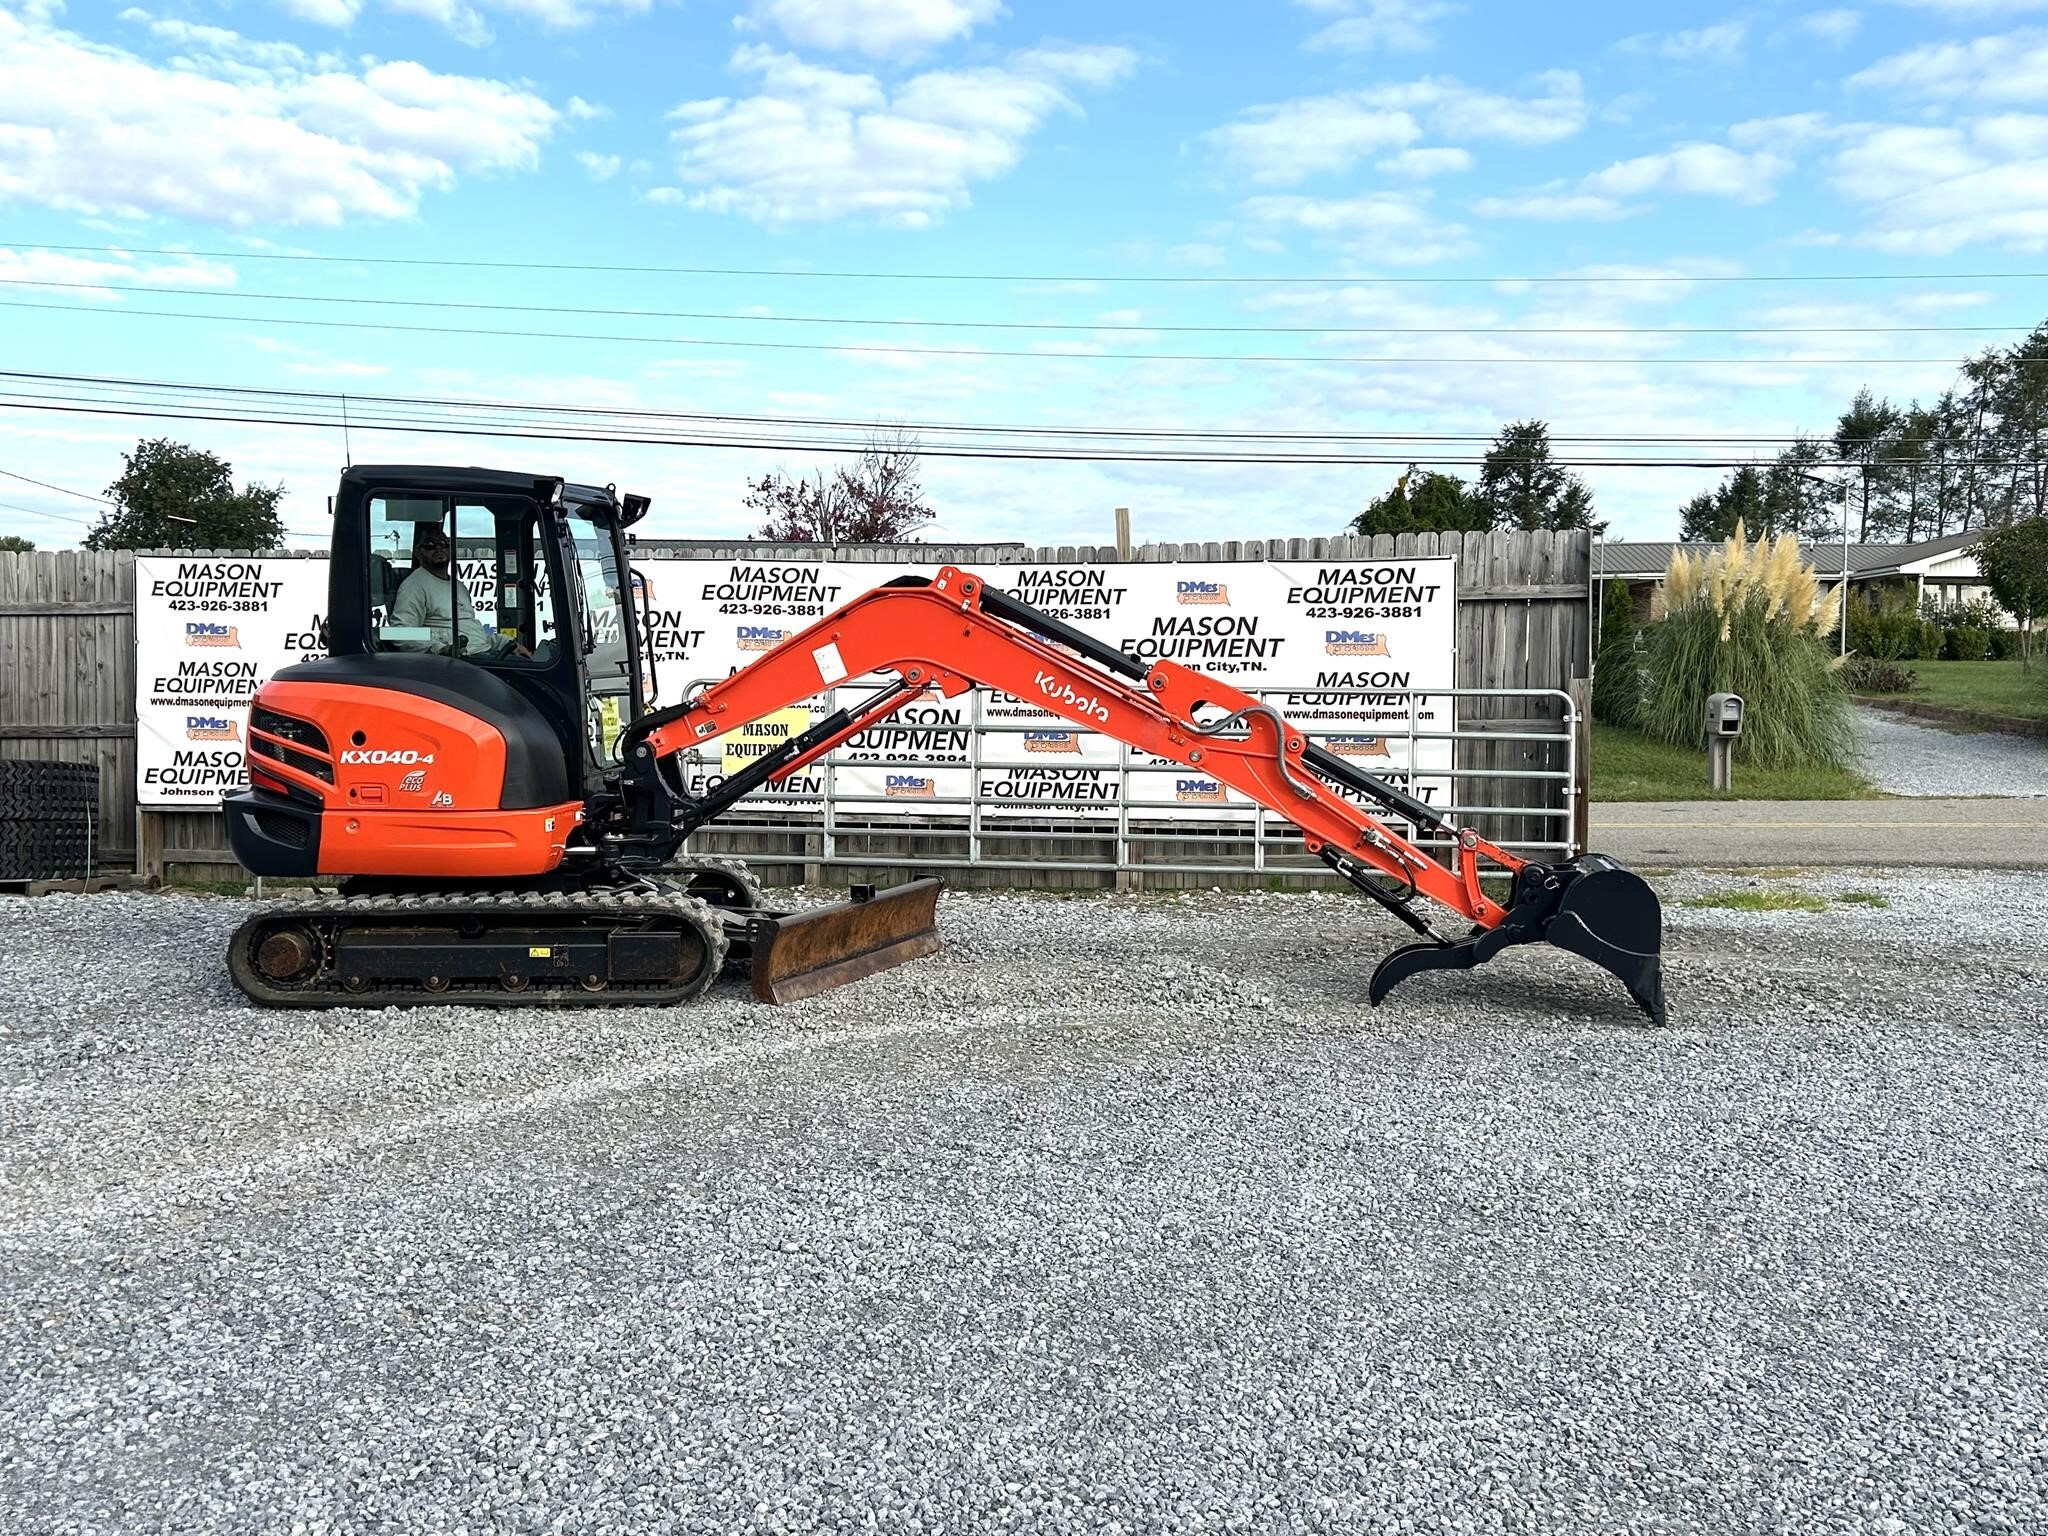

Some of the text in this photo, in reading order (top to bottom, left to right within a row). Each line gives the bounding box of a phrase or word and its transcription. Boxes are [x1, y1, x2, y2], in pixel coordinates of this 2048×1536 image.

[178, 564, 262, 580] MASON
[730, 566, 819, 584] MASON
[1017, 570, 1105, 587] MASON
[1317, 567, 1416, 586] MASON
[151, 581, 283, 598] EQUIPMENT
[702, 584, 841, 603] EQUIPMENT
[999, 588, 1127, 605] QUIPMENT
[1287, 586, 1440, 604] EQUIPMENT
[168, 600, 268, 612] 423-926-3881
[718, 603, 824, 616] 423-926-3881
[1305, 607, 1422, 618] 423-926-3881
[1151, 616, 1258, 636] MASON
[1121, 638, 1285, 658] EQUIPMENT
[178, 661, 258, 678] MASON
[1205, 662, 1267, 673] City,TN.
[153, 678, 263, 694] EQUIPMEN
[1316, 672, 1410, 688] MASON
[1034, 670, 1109, 723] Kubota
[878, 708, 961, 725] ASON
[1283, 709, 1434, 722] www.dmasonequipment.om
[743, 724, 789, 737] MASON
[837, 731, 986, 750] QUIPMEN
[173, 751, 246, 768] MASO
[340, 750, 434, 764] KX040-4
[145, 768, 249, 785] EQUIPME
[406, 776, 424, 784] eco
[160, 788, 214, 796] Johnson
[399, 783, 422, 792] PLUS
[980, 781, 1119, 799] EQUIPMENT
